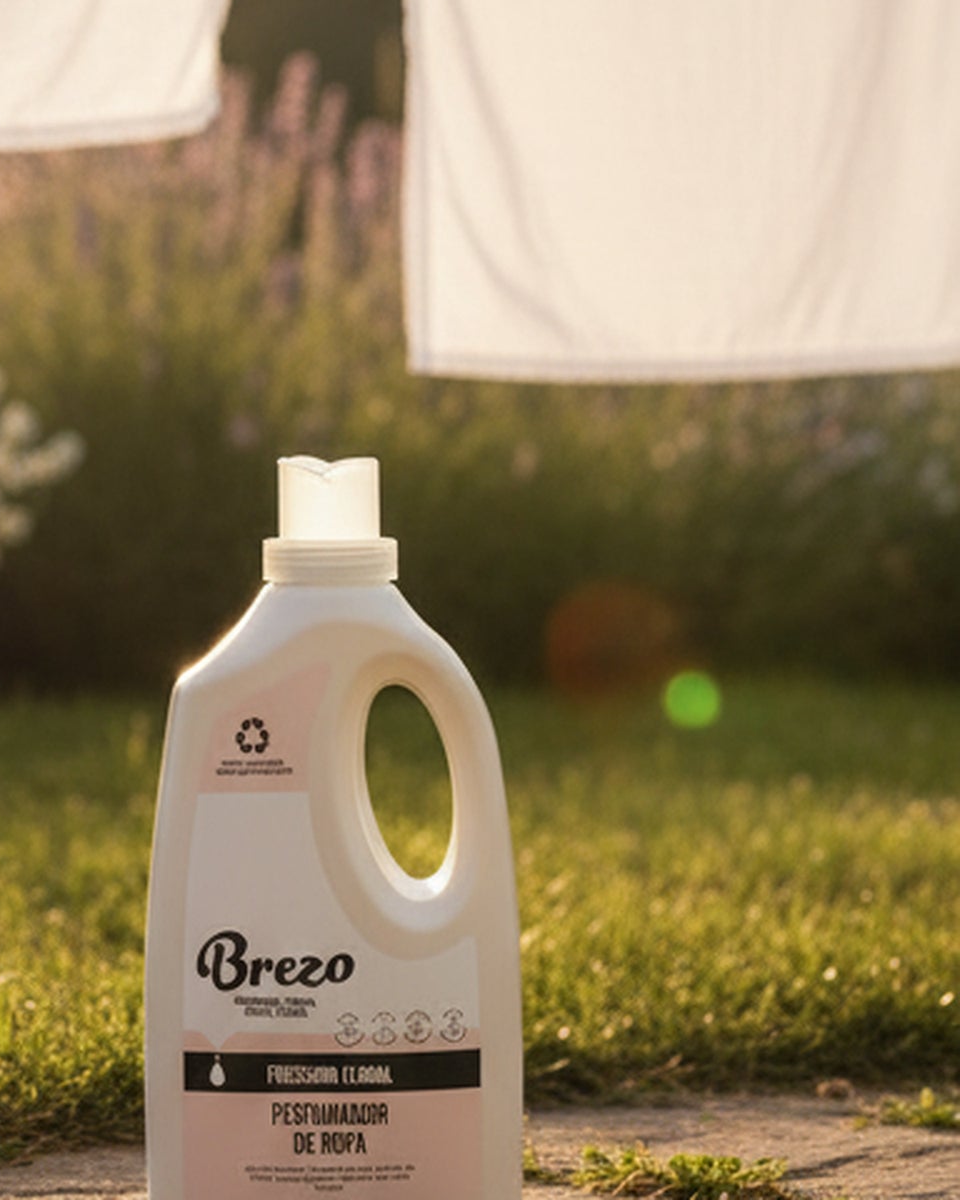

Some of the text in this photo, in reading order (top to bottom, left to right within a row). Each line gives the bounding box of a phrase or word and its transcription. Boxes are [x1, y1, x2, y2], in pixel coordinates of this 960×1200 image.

[196, 930, 355, 992] Brezo
[293, 1132, 367, 1155] DE ROPA
